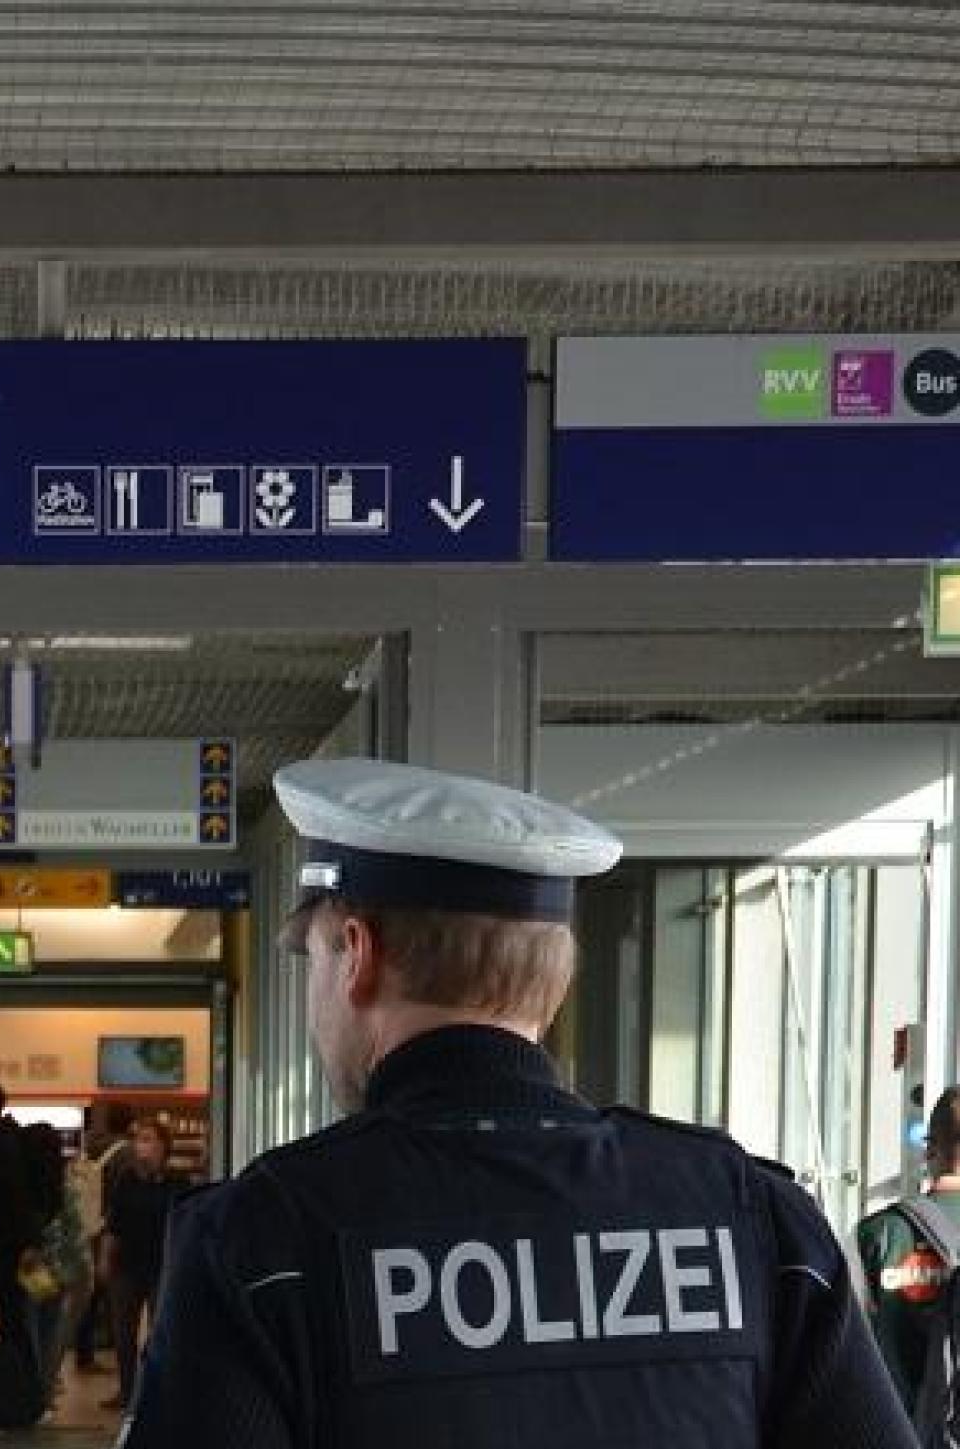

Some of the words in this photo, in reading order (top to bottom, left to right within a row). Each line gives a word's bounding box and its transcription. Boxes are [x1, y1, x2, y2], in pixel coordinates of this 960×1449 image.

[763, 369, 820, 394] RVV
[916, 372, 958, 394] Bus
[372, 1226, 743, 1354] POLIZEI
